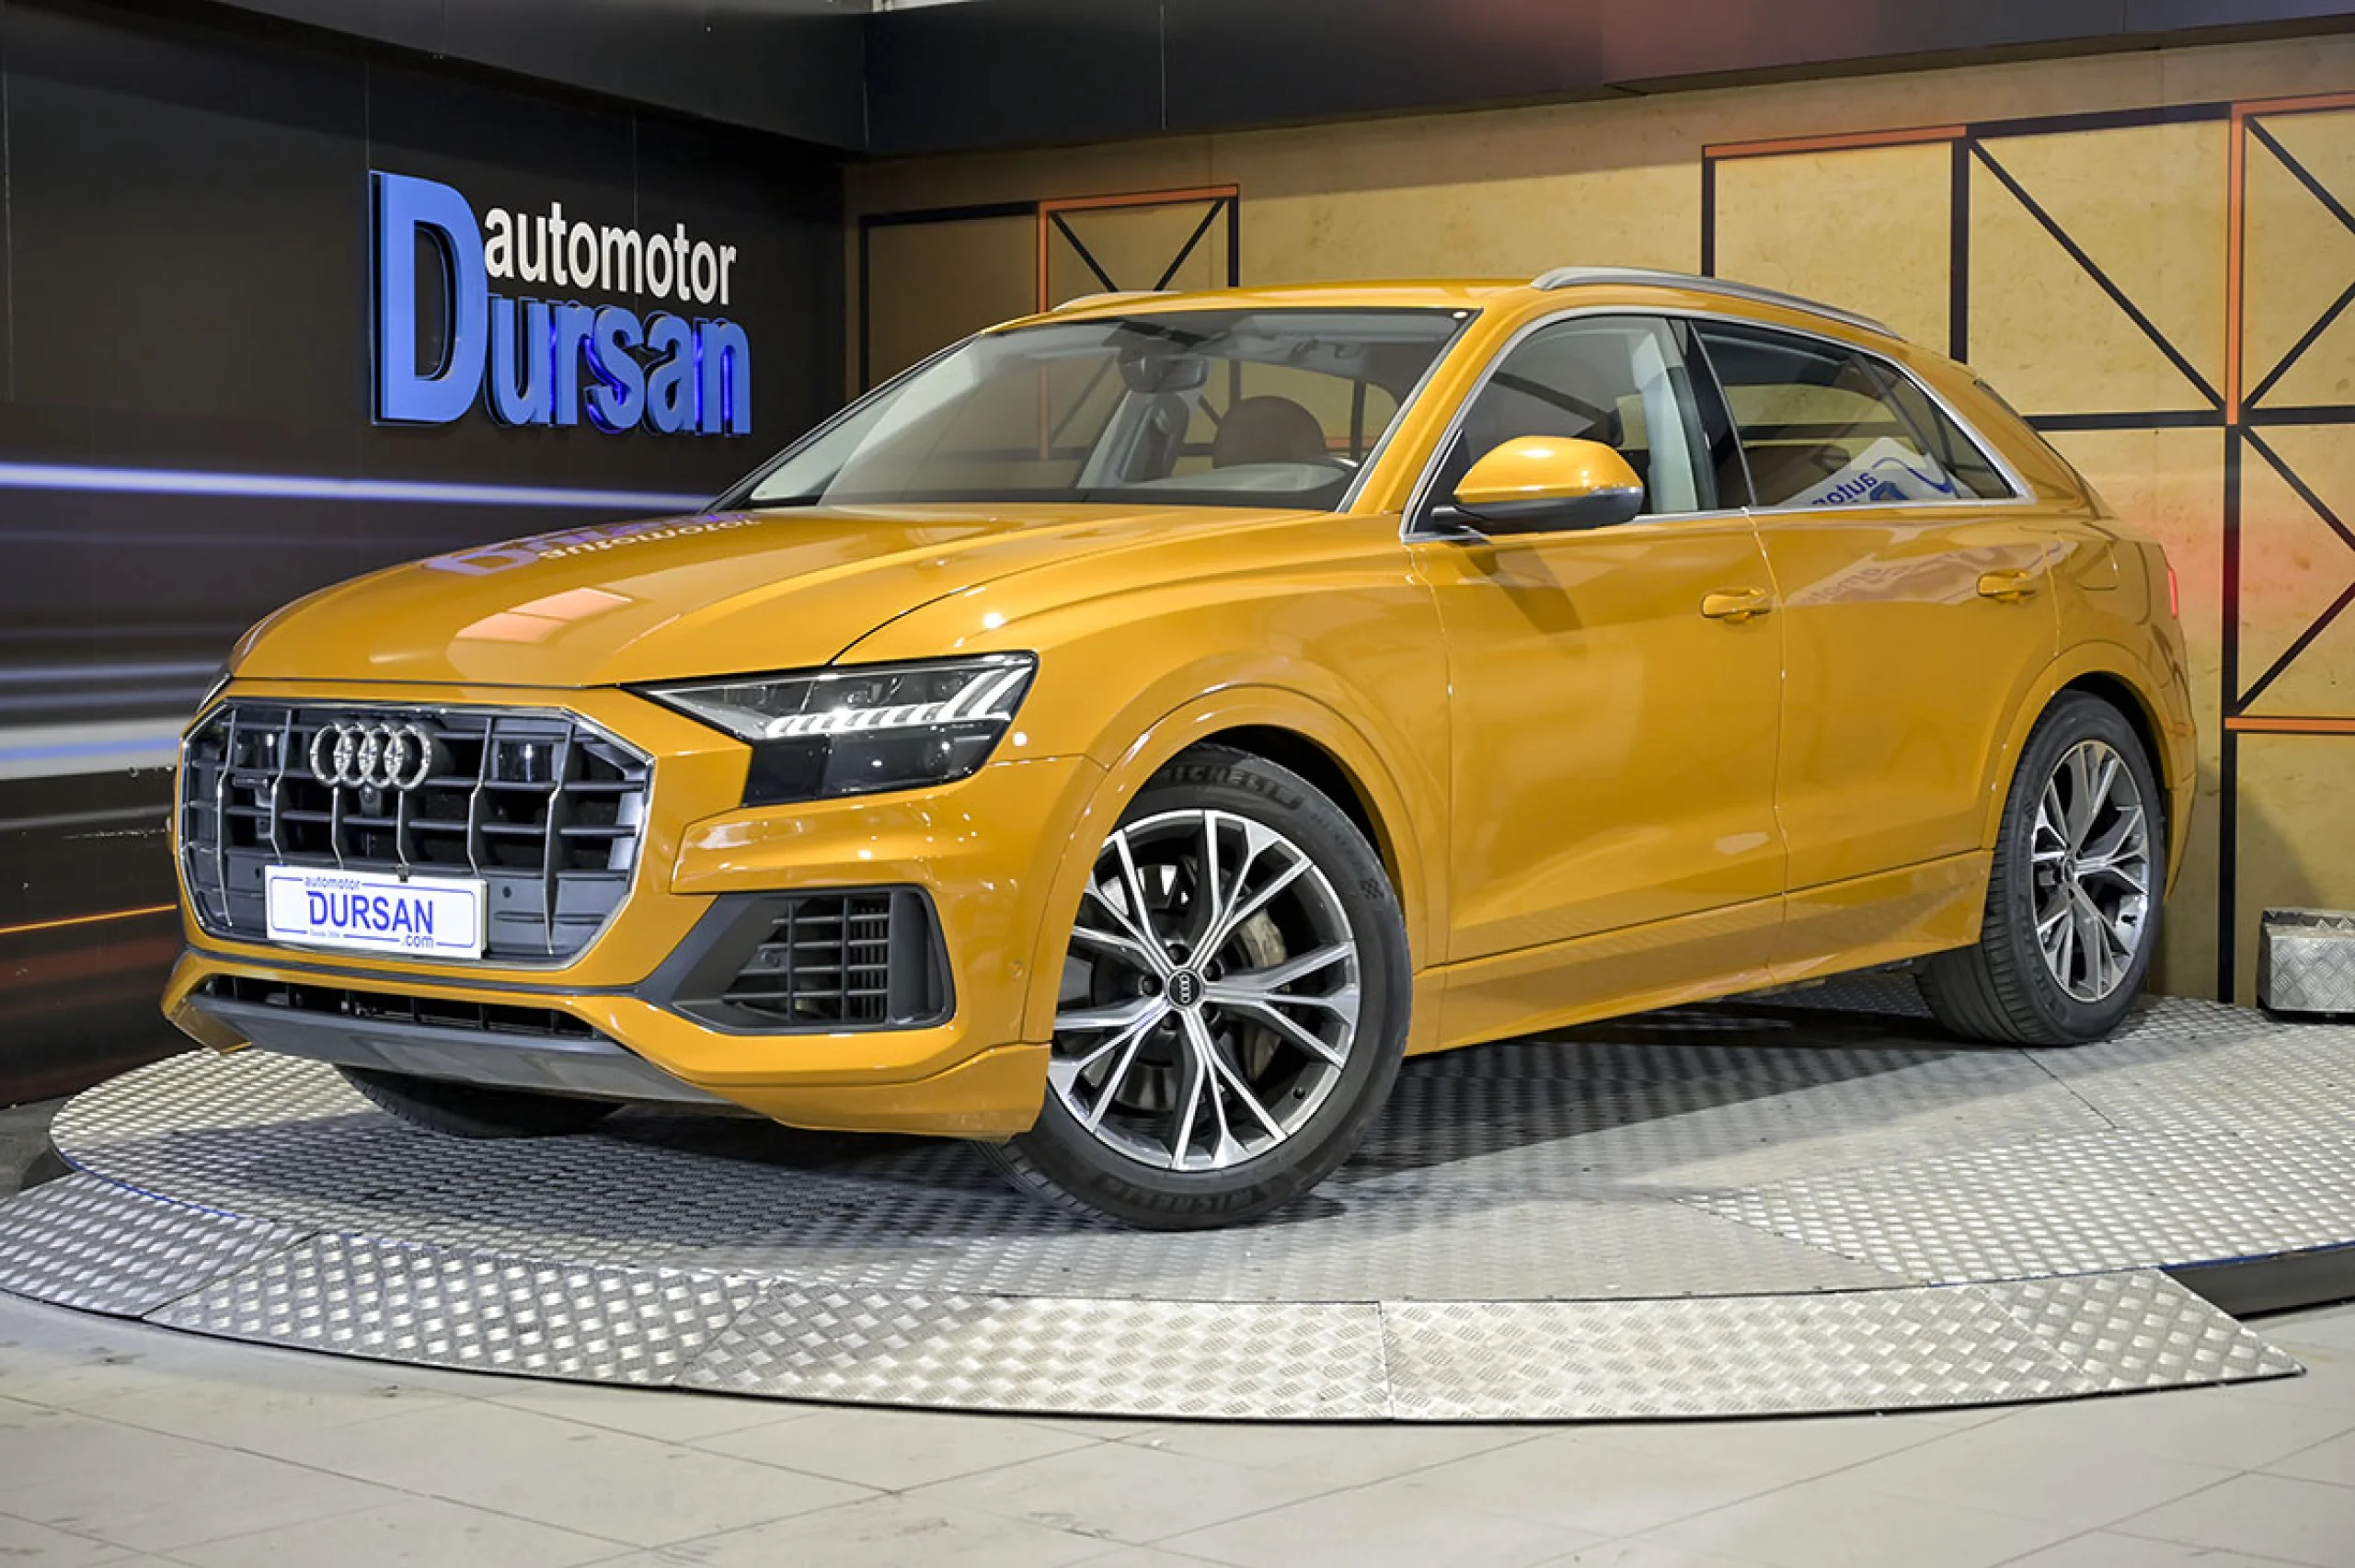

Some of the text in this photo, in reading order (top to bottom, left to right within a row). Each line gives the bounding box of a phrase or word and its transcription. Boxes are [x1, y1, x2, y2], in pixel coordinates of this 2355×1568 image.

[484, 201, 736, 305] automotor
[370, 170, 752, 437] Dursan
[304, 876, 361, 890] automotor
[306, 890, 433, 934] DURSAN
[401, 934, 434, 948] .com
